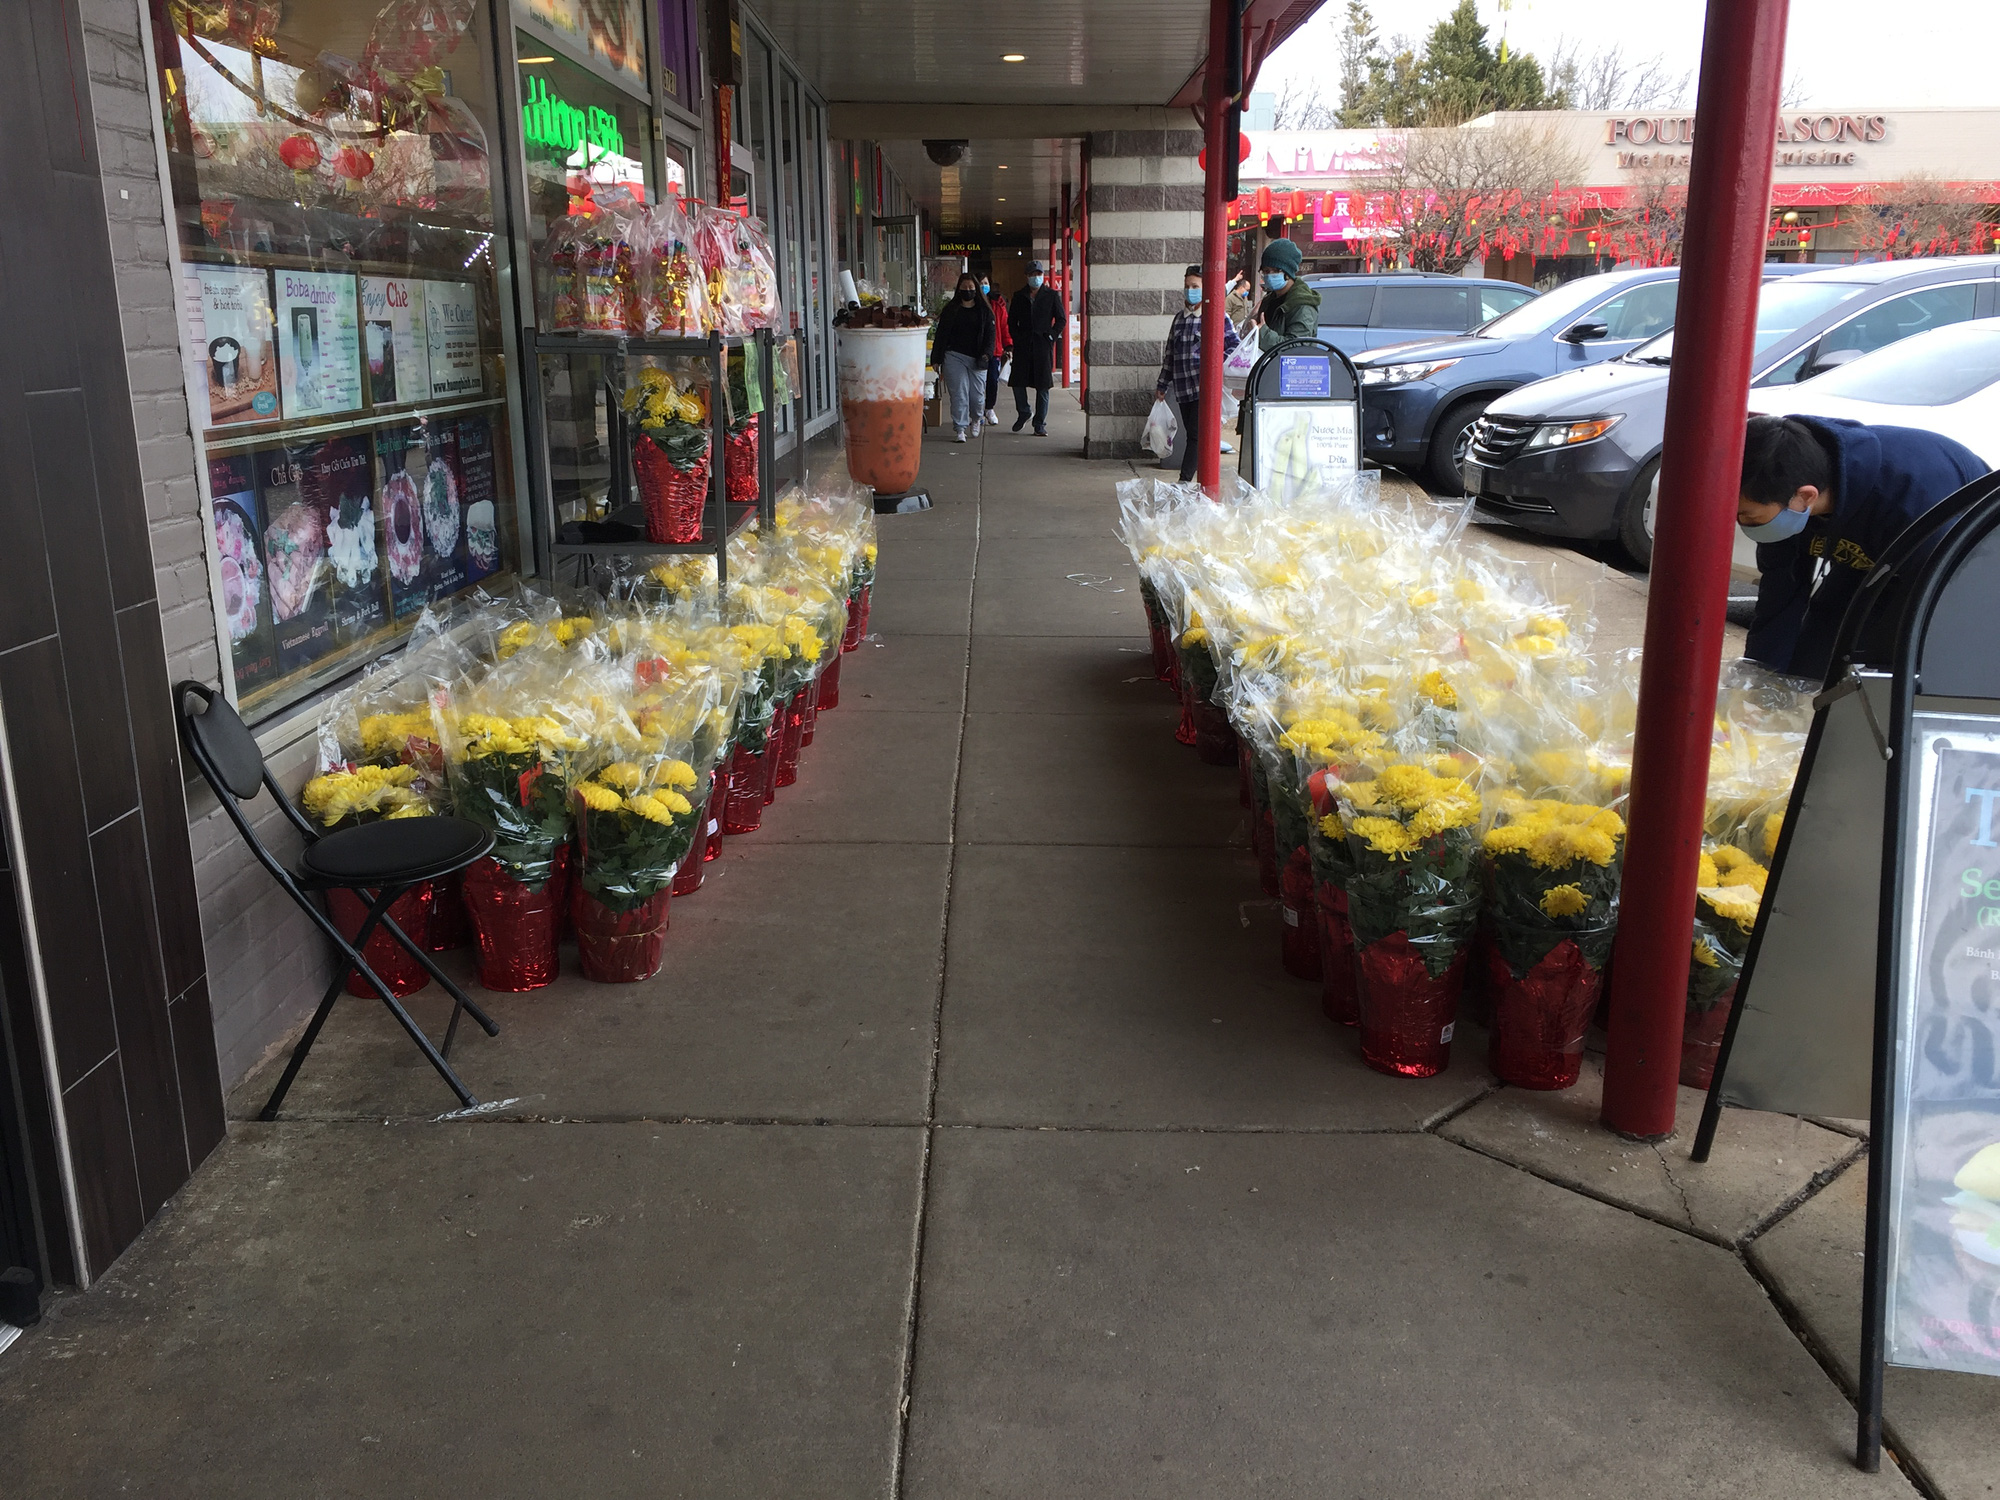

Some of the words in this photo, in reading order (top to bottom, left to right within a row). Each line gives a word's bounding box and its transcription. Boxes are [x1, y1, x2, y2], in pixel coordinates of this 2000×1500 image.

[1778, 114, 1888, 143] ASONS
[1616, 151, 1691, 169] Vietna
[967, 243, 981, 251] GIA
[285, 277, 310, 298] Boba
[310, 285, 337, 304] drinks
[386, 281, 409, 308] Chè
[442, 303, 454, 322] We
[1960, 867, 2000, 900] Se
[1965, 946, 1995, 960] Bánh
